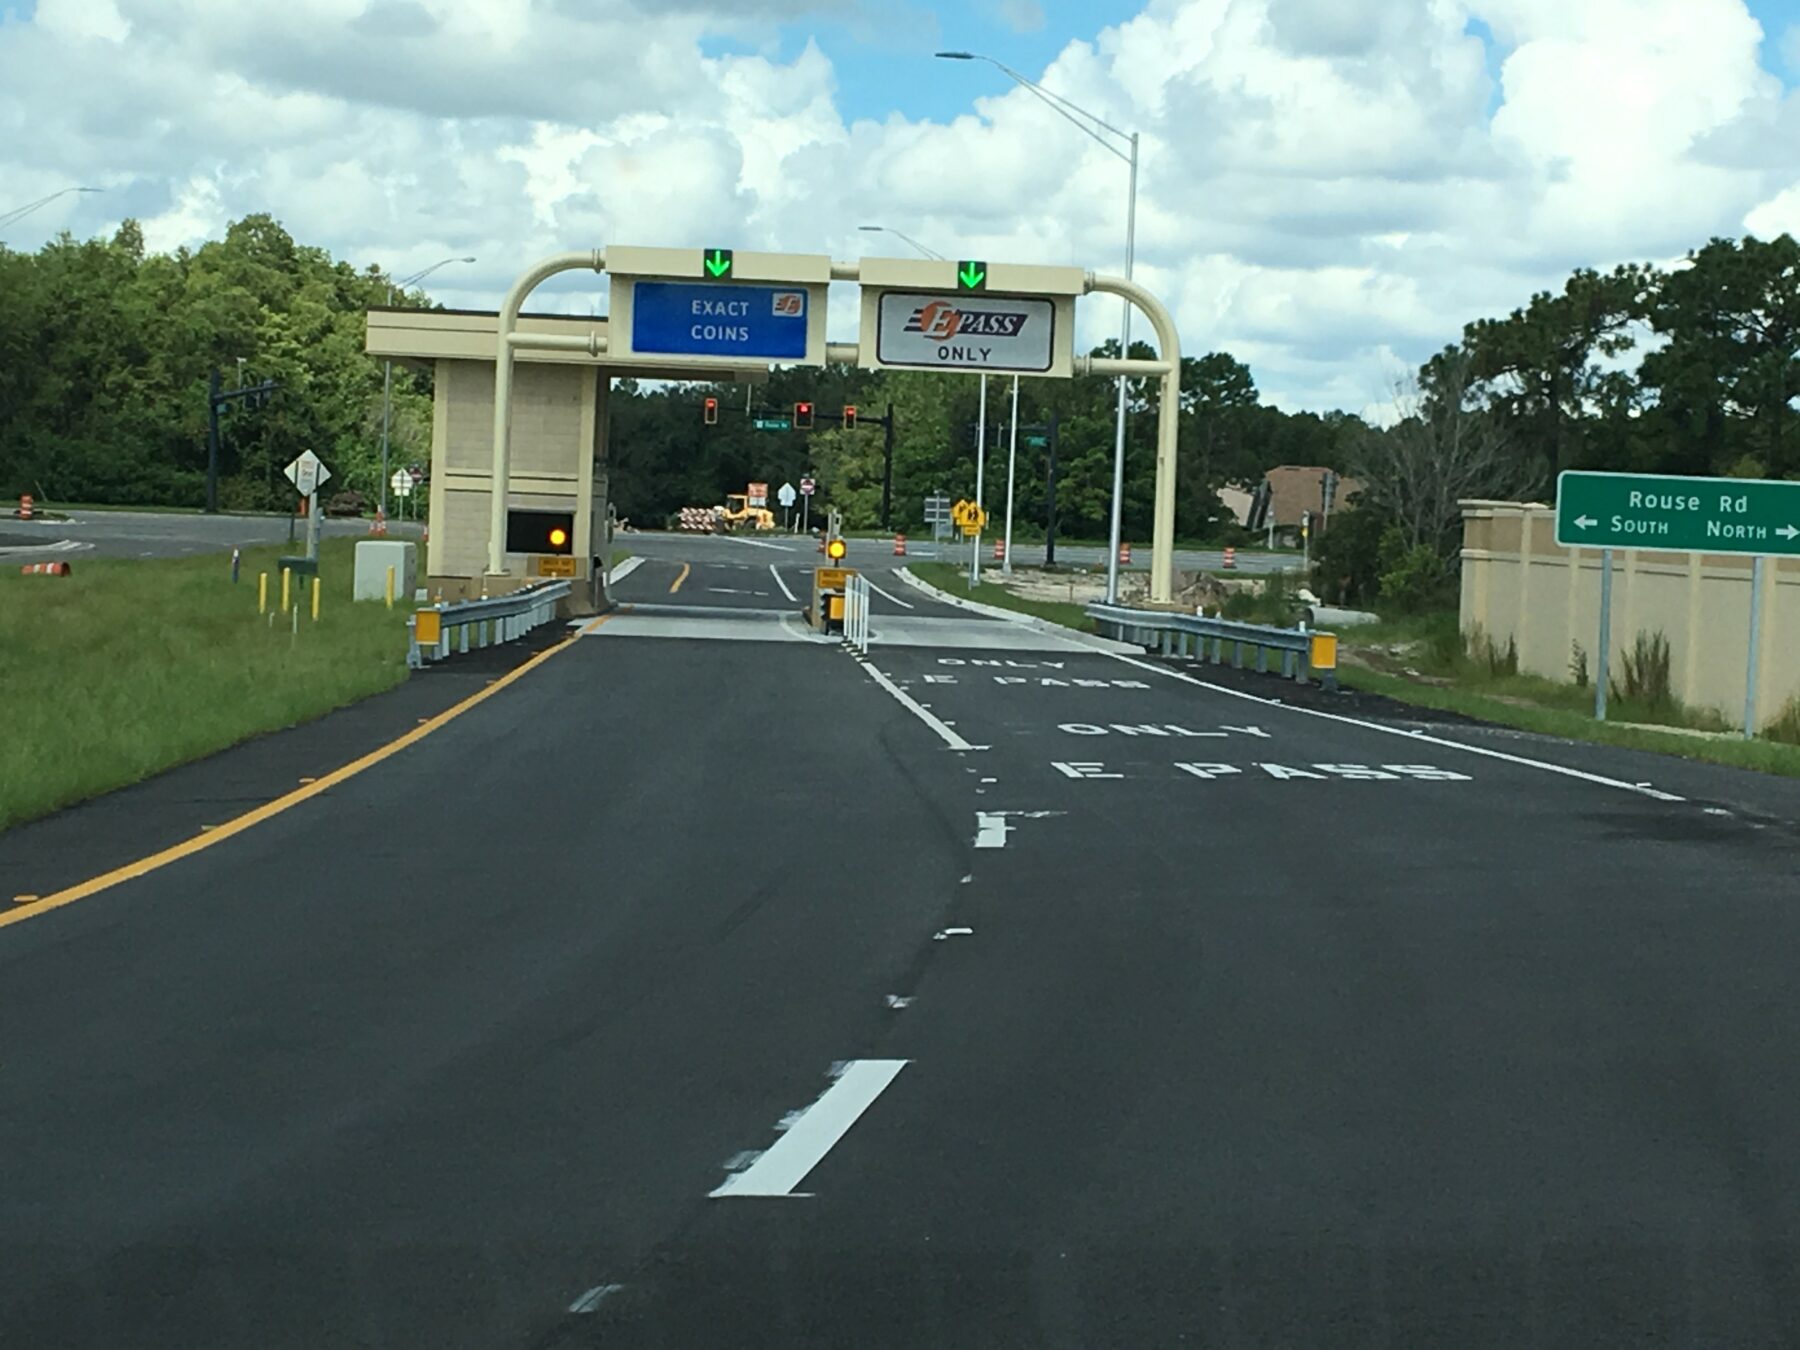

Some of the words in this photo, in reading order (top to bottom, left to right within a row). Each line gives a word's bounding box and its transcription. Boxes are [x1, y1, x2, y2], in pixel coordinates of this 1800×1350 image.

[691, 300, 749, 317] EXACT
[691, 325, 749, 341] COINS
[938, 346, 991, 361] ONLY
[1629, 491, 1700, 511] Rouse
[1719, 495, 1748, 513] Rd
[937, 658, 1064, 669] ONLY
[923, 674, 958, 683] E
[993, 676, 1151, 689] PASS
[1057, 723, 1271, 738] ONLY
[1051, 761, 1124, 778] E
[1174, 761, 1473, 780] PASS
